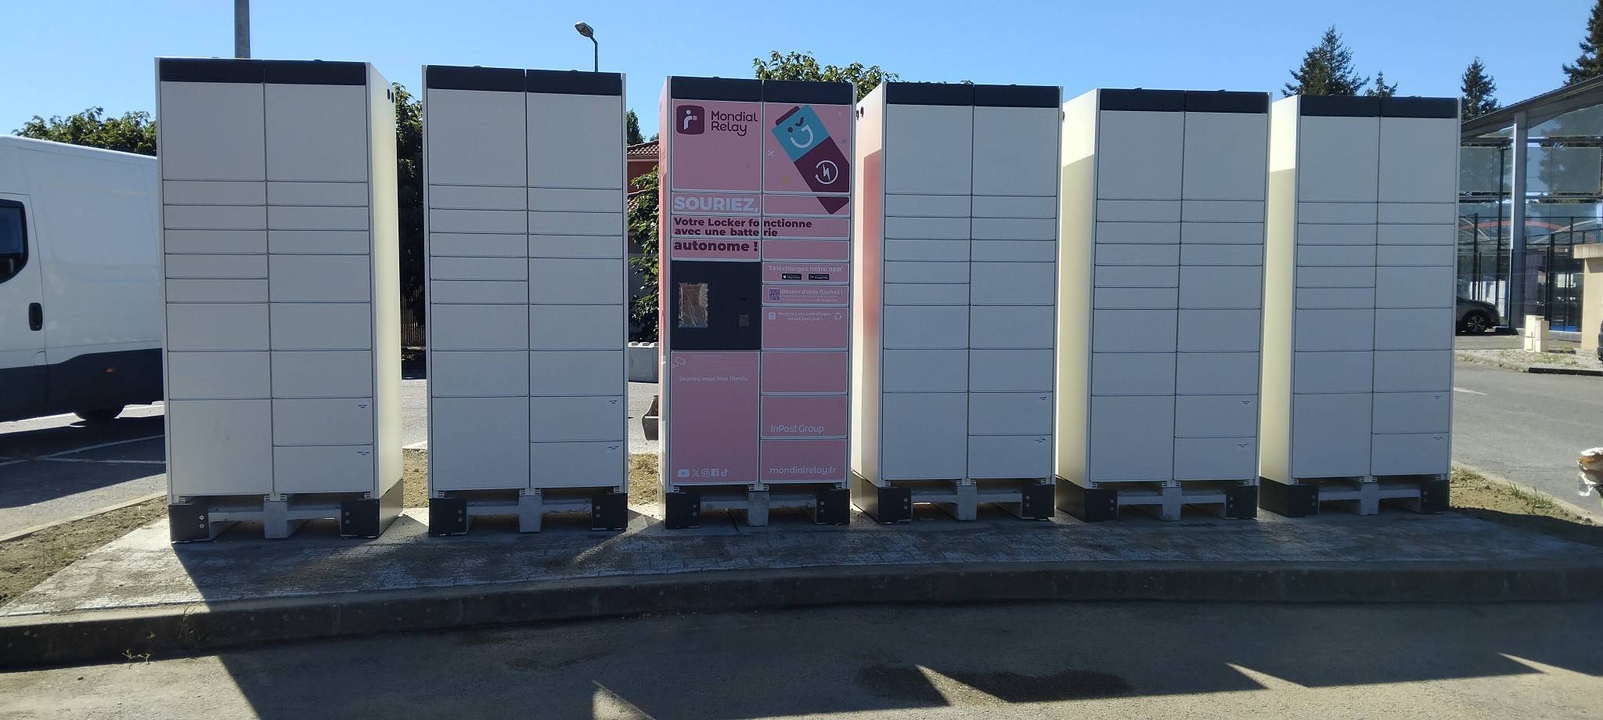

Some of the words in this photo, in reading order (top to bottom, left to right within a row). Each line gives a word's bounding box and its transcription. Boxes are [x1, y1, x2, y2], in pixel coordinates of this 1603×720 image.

[711, 110, 758, 122] Mondial
[711, 121, 748, 136] Relay
[674, 196, 759, 214] SOURIEZ,
[674, 217, 706, 226] Votre
[708, 218, 746, 228] Locker
[748, 218, 812, 228] fonctionne
[730, 228, 778, 236] batterie
[674, 240, 750, 252] autonome
[753, 241, 758, 252] !
[770, 424, 798, 433] InPost
[798, 424, 824, 434] Group
[770, 466, 836, 476] mondialrelay.fr
